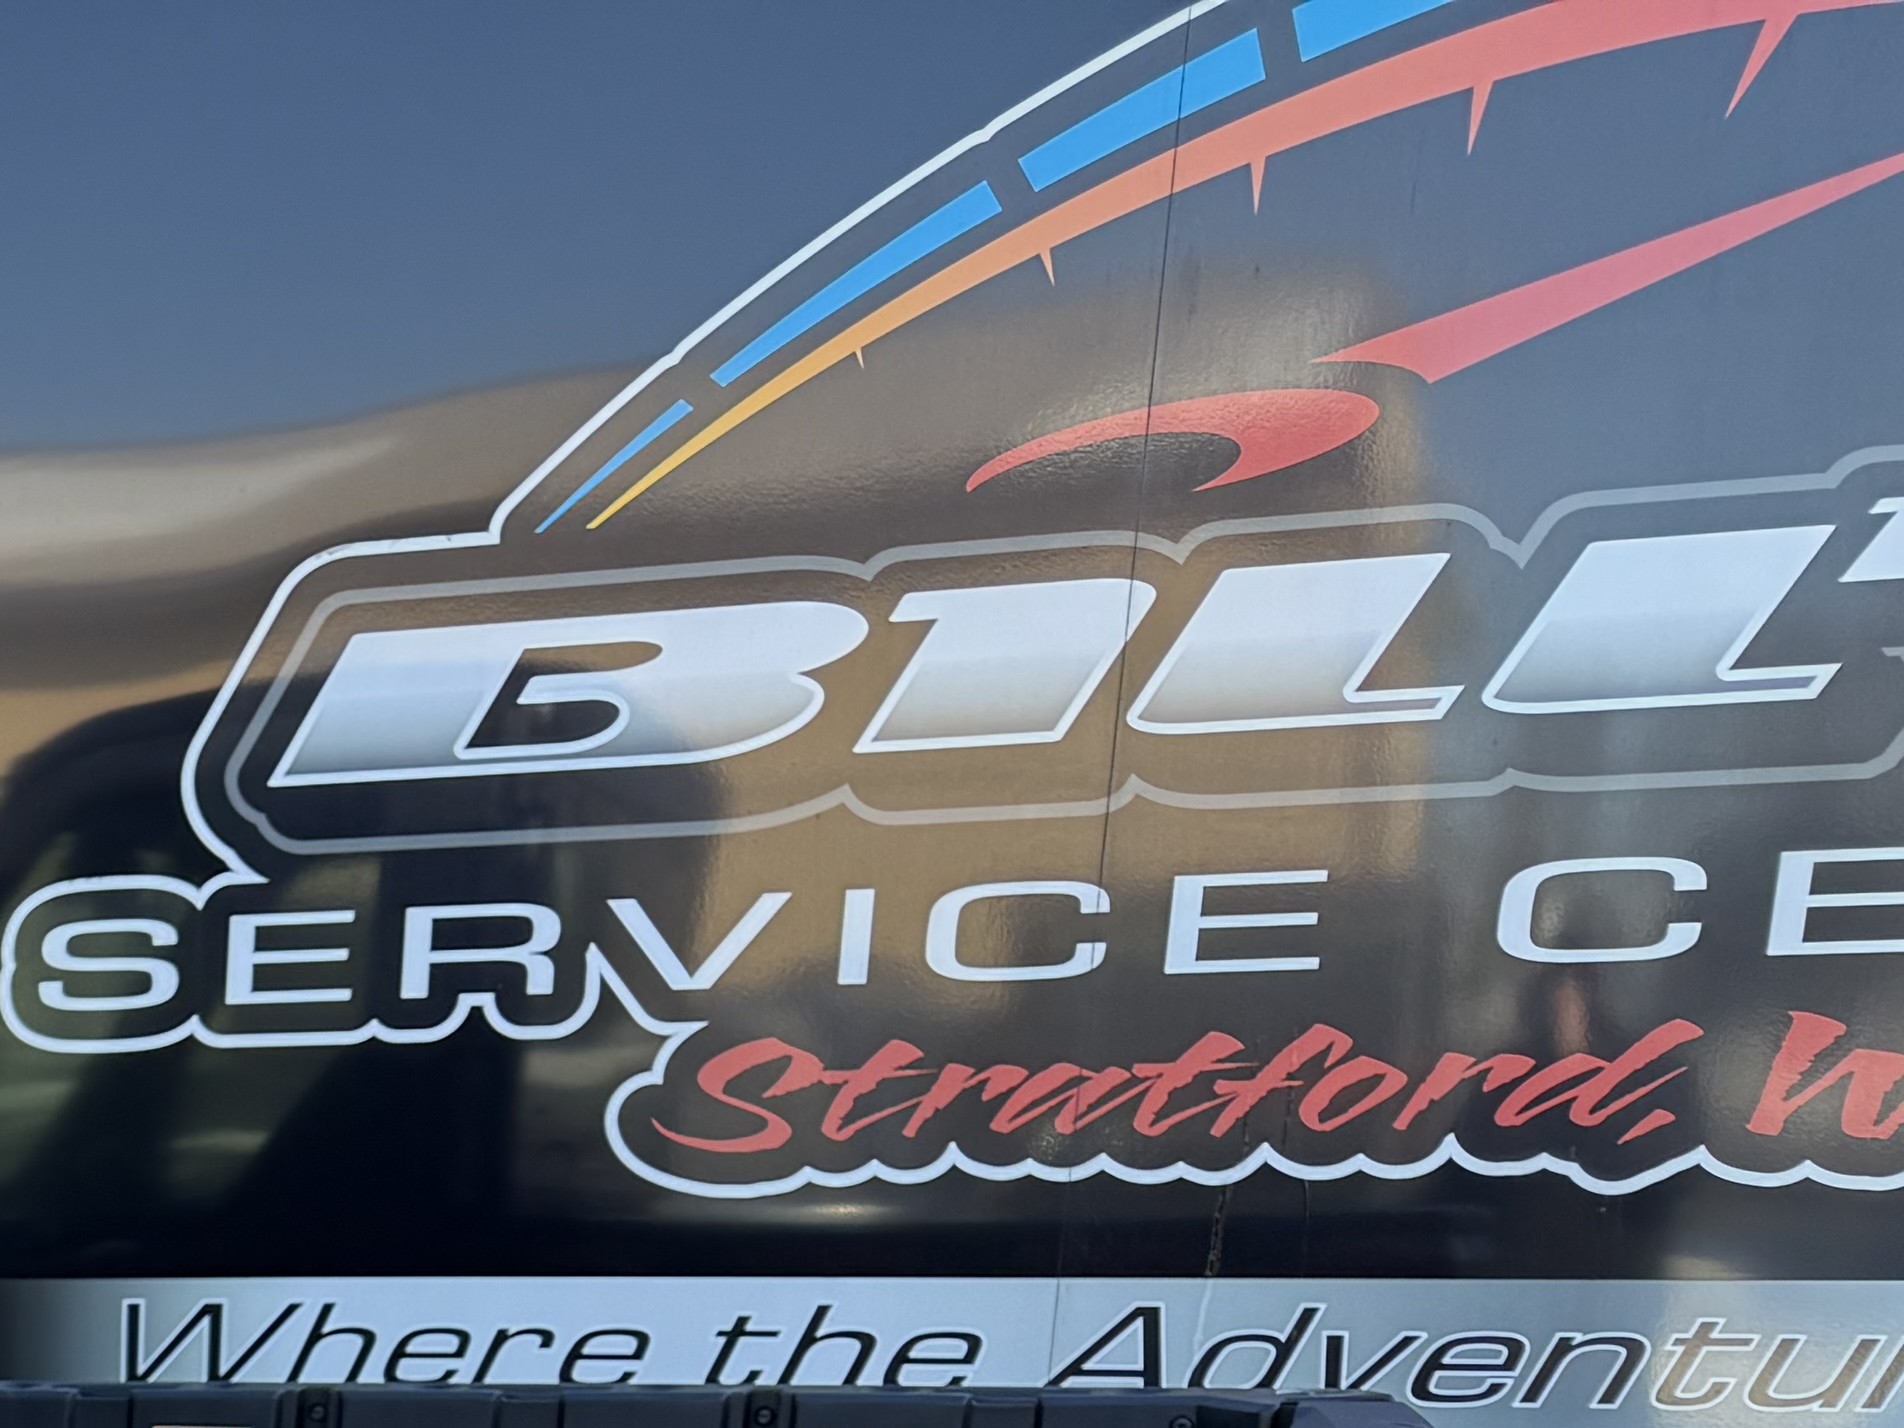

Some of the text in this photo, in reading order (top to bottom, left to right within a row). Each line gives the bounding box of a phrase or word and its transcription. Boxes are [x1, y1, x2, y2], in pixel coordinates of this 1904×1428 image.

[37, 868, 1329, 1011] SERVICE
[650, 1018, 1704, 1153] Stratford,
[122, 1300, 654, 1387] Where
[704, 1302, 986, 1388] the
